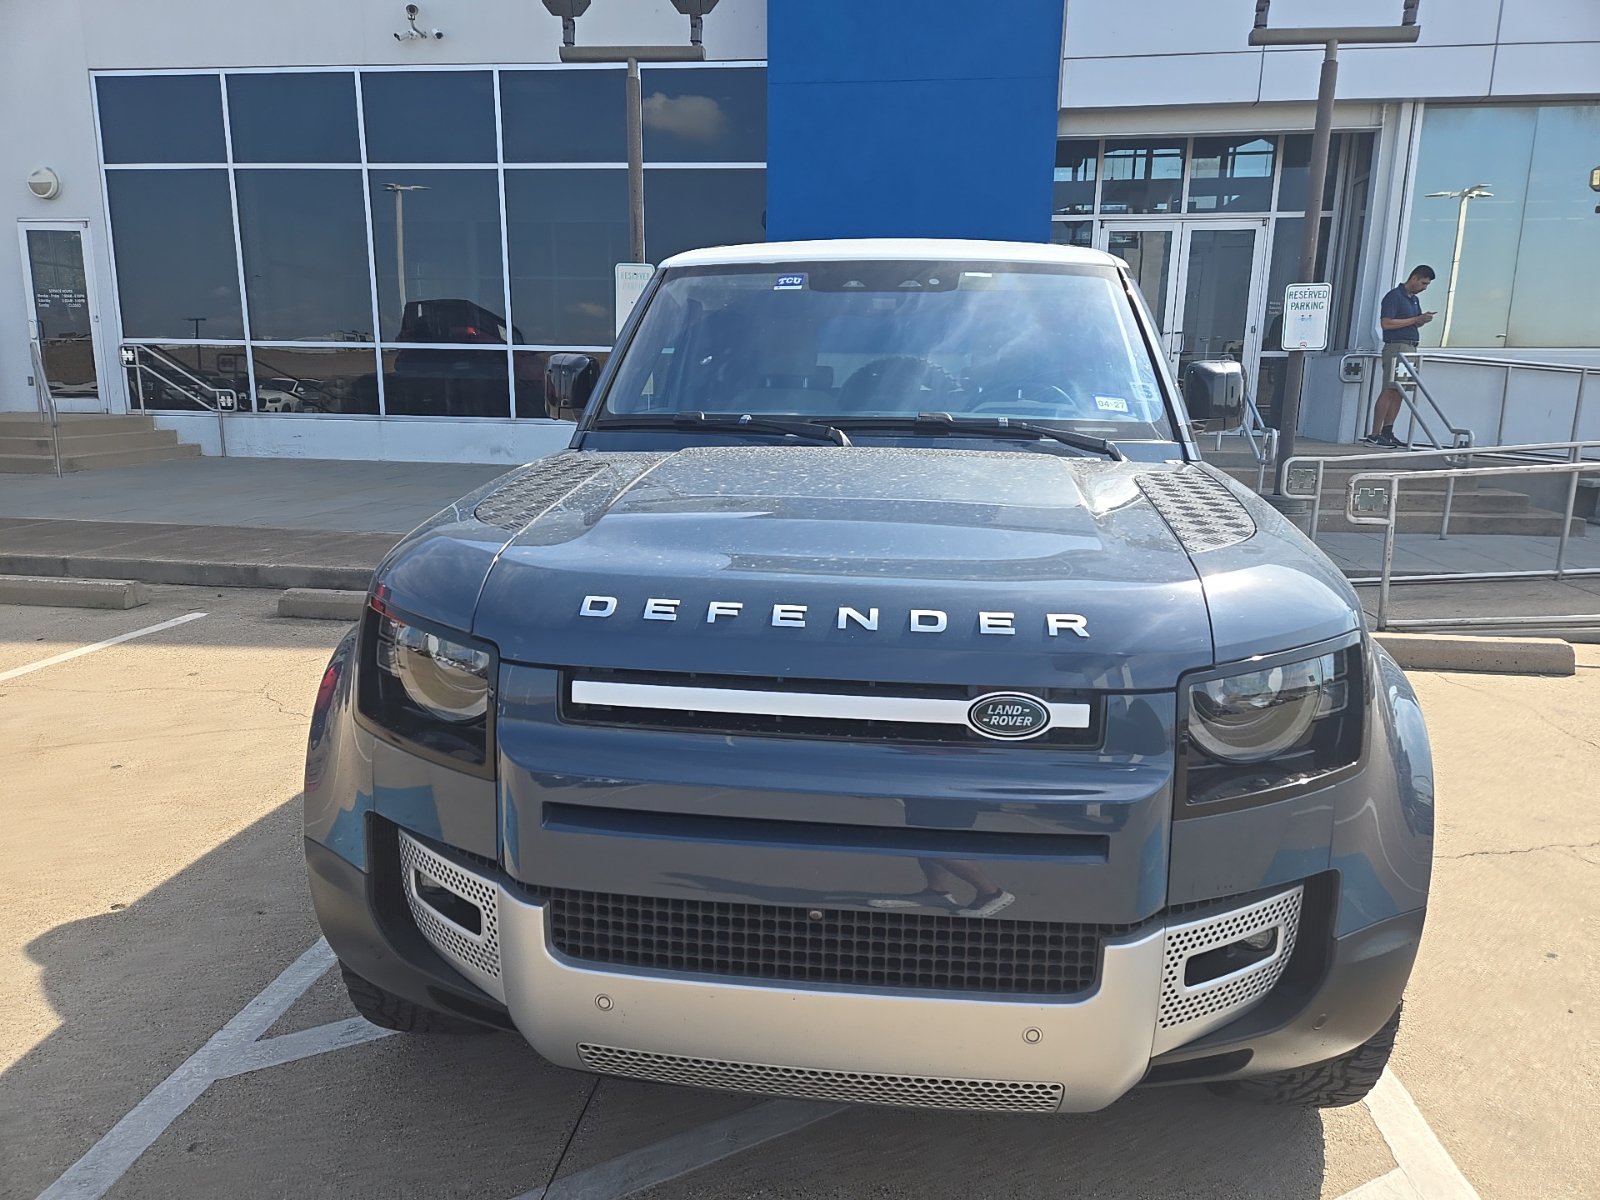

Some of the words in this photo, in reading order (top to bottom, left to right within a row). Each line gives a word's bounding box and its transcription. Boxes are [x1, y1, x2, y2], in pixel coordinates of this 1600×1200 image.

[778, 277, 802, 285] TCU
[1289, 290, 1328, 300] RESERVED
[1290, 301, 1324, 310] PARKING
[579, 595, 1091, 637] DEFENDER
